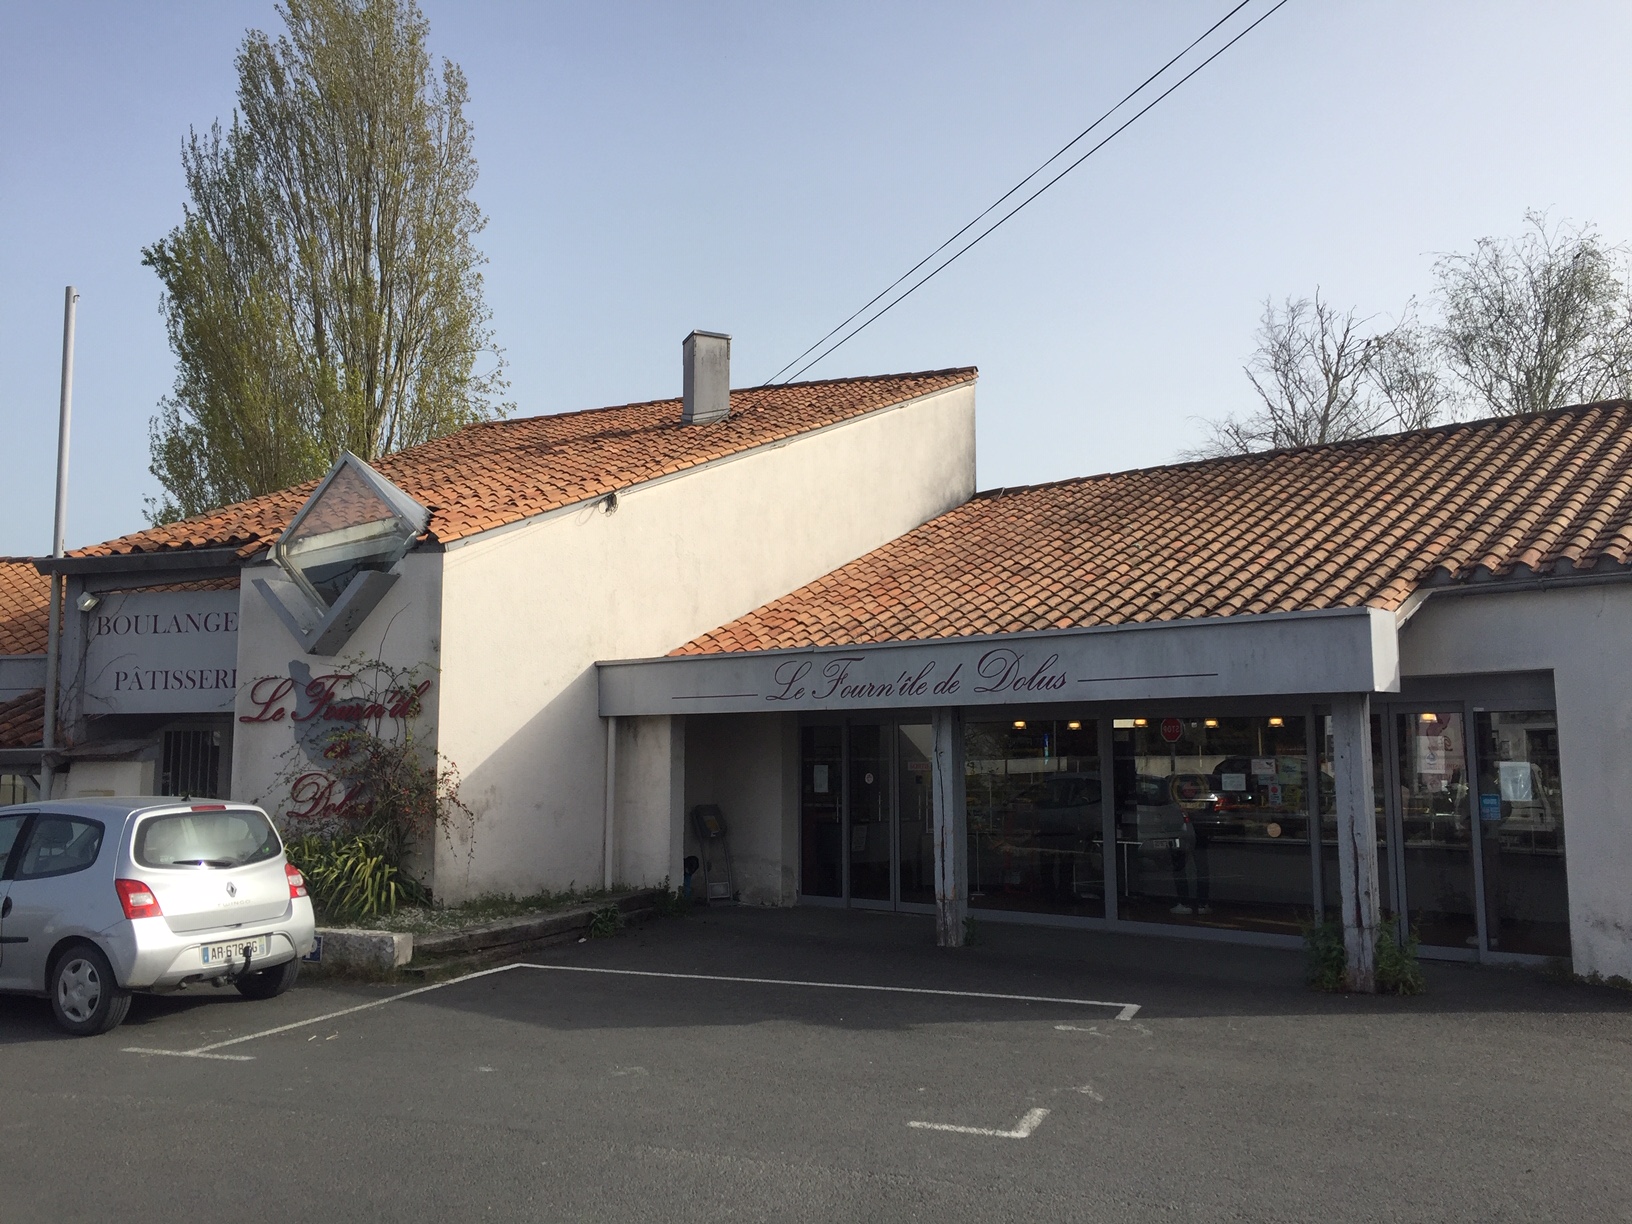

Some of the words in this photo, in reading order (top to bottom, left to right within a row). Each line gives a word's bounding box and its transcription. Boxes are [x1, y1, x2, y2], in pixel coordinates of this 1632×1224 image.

[96, 611, 239, 636] BOULANGE
[114, 666, 237, 691] PÂTISSERI
[765, 660, 813, 701] Le
[932, 663, 963, 695] de
[973, 648, 1068, 693] Dolus
[238, 676, 295, 723] Le
[217, 899, 251, 909] TWINGO
[211, 940, 258, 960] AR-678G
